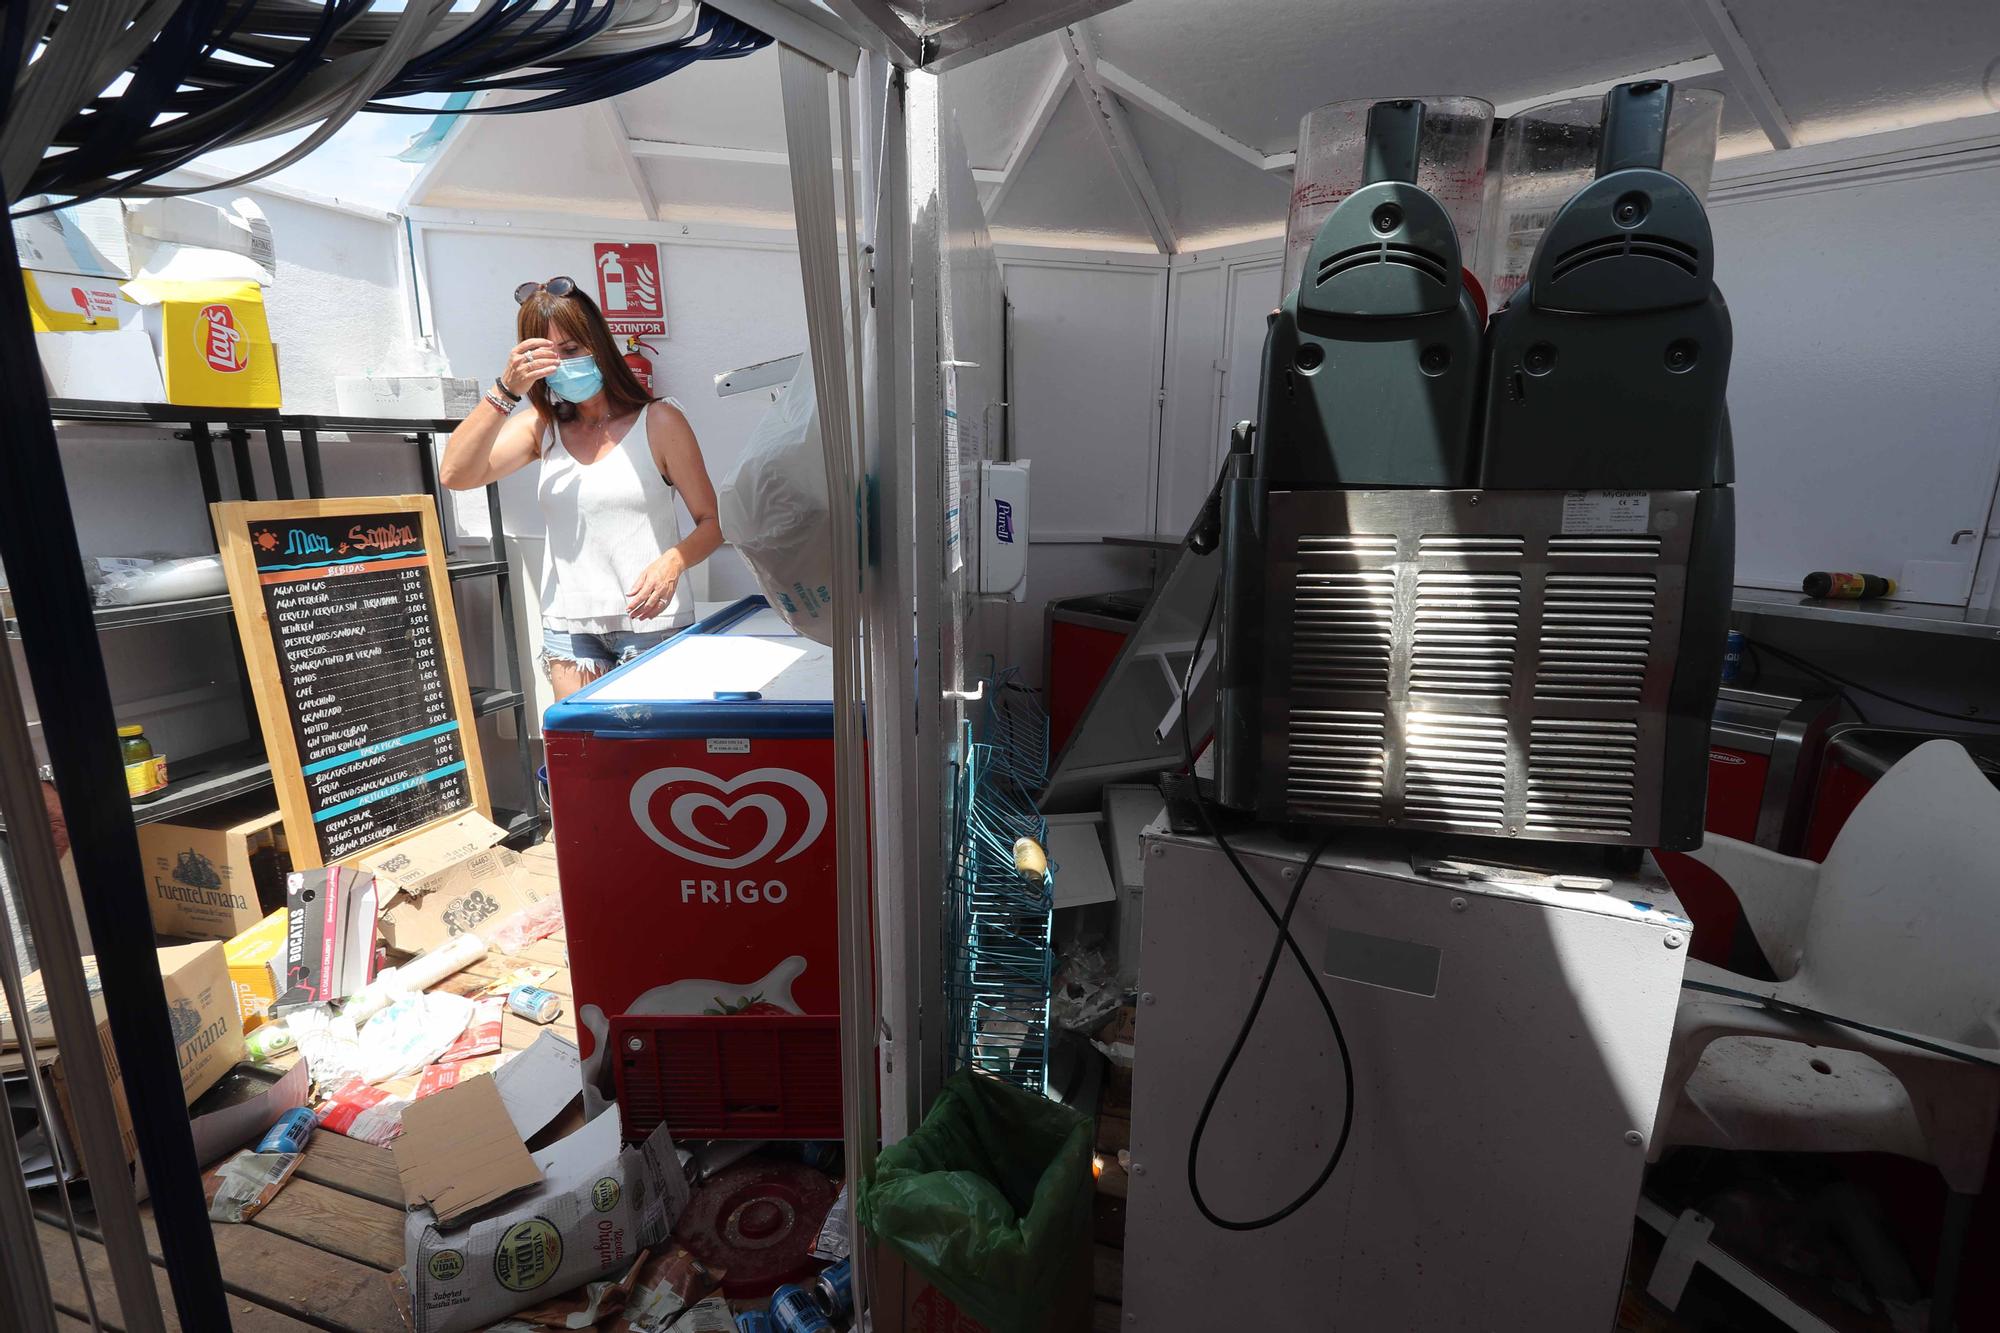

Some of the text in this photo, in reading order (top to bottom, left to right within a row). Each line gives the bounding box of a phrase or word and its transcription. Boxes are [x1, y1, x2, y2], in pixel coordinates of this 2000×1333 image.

[681, 224, 689, 234] 2
[608, 323, 661, 333] EXTINTOR
[998, 504, 1010, 539] Purell
[284, 524, 416, 554] Mar y Sombra
[326, 563, 364, 576] BEBIDAS
[272, 585, 294, 596] AGUA
[294, 582, 310, 592] CON
[310, 580, 326, 591] GAS
[275, 598, 297, 609] AGUA
[297, 593, 329, 605] PEQUEÑA
[278, 609, 310, 621] CERVEZA
[281, 621, 314, 634] HEINEKEN
[344, 652, 354, 662] DE
[354, 646, 382, 659] VERANO
[293, 672, 317, 685] ZUMOS
[295, 684, 313, 698] CAFÉ
[301, 705, 342, 723] GRANIZADO
[303, 721, 329, 735] MOJITO
[306, 735, 320, 747] GIN
[309, 744, 336, 759] CHUPITO
[317, 780, 339, 794] FRUTA
[325, 818, 348, 832] CREMA
[348, 809, 372, 824] SOLAR
[327, 828, 352, 845] JUEGOS
[352, 820, 374, 834] PLAYA
[154, 875, 248, 910] FuenteLiviana
[680, 879, 788, 904] FRIGO
[289, 908, 304, 963] BOCATAS
[177, 1016, 228, 1070] Liviana
[514, 1226, 535, 1287] VIDAL
[533, 1233, 545, 1273] VICENTE
[432, 1260, 460, 1272] VIDAL
